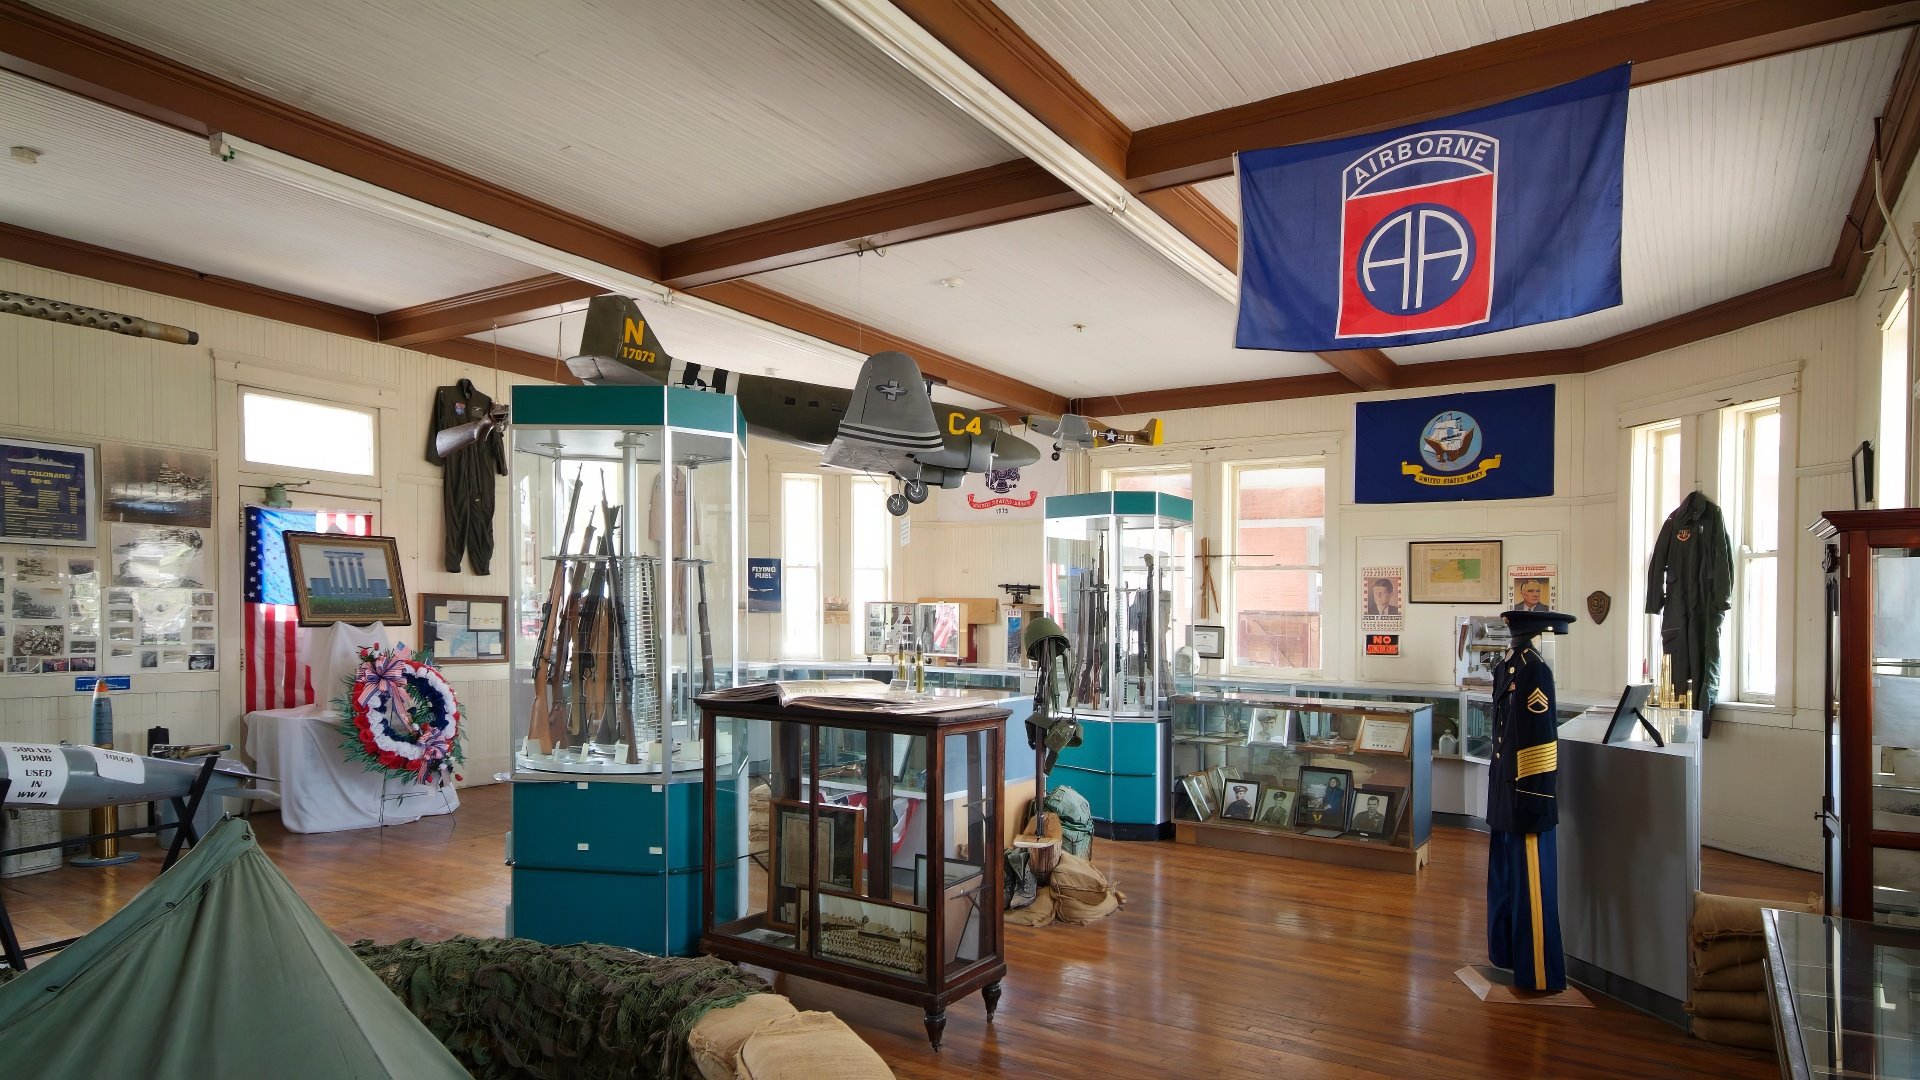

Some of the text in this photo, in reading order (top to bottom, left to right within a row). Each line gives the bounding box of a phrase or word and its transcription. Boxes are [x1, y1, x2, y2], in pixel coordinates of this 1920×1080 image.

[1354, 136, 1491, 185] AIRBORNE
[1362, 209, 1469, 310] AA
[624, 318, 644, 345] N
[623, 347, 655, 363] 17073
[949, 413, 981, 435] C4
[1373, 636, 1391, 644] NO
[21, 754, 52, 762] BOMB
[105, 753, 133, 763] TOUCH
[25, 769, 52, 777] USED
[31, 780, 42, 788] IN
